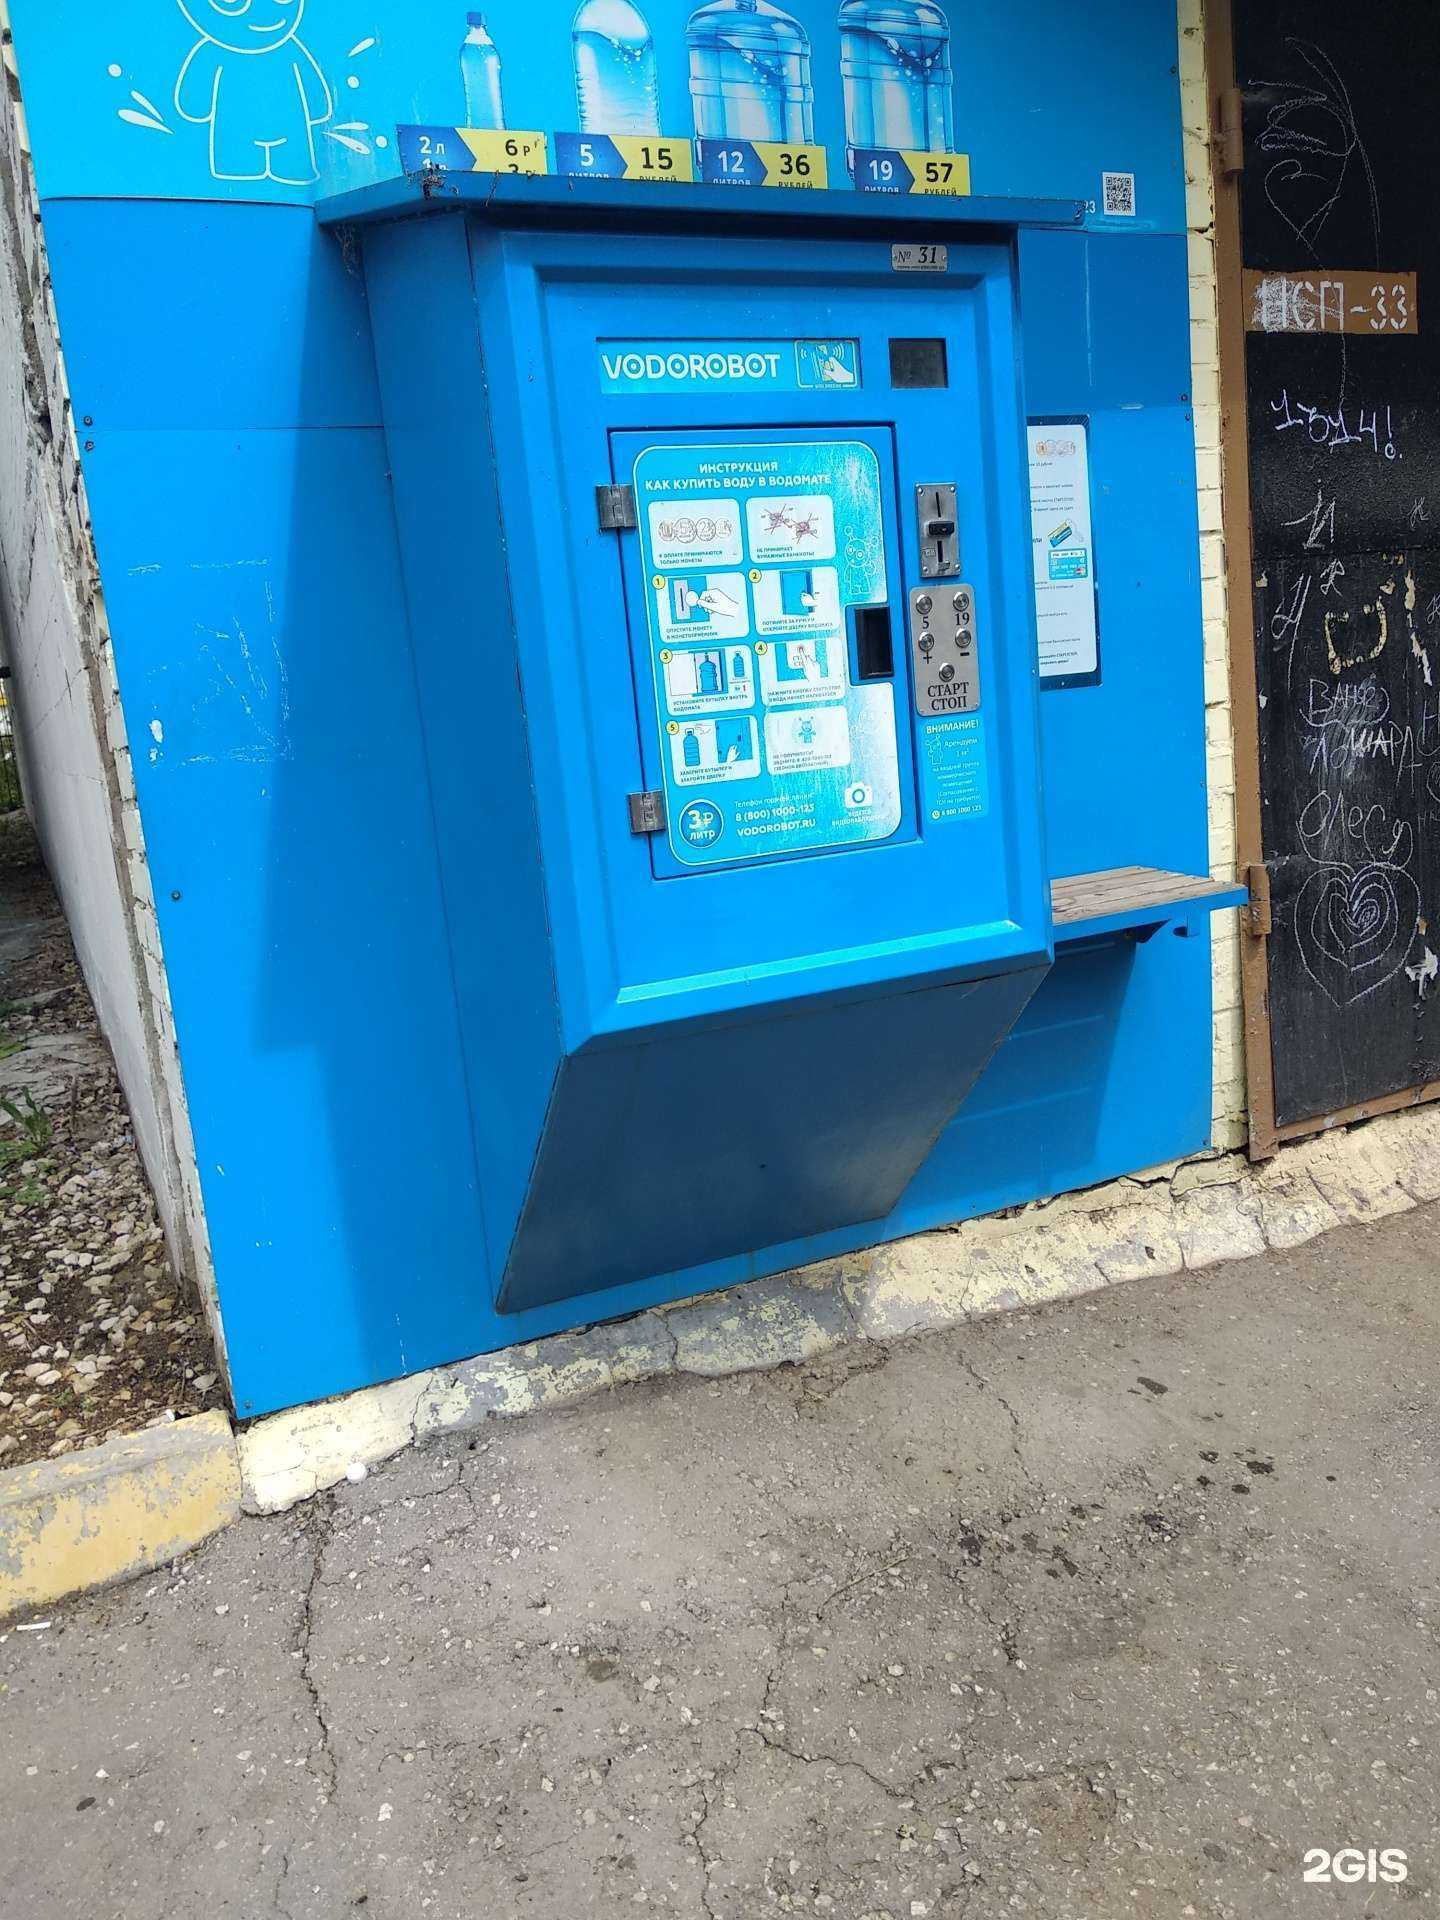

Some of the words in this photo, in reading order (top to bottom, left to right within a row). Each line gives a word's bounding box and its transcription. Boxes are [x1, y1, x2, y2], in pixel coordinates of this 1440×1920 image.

[419, 136, 432, 155] 2
[505, 139, 518, 157] 6
[580, 144, 593, 166] 5
[640, 147, 673, 170] 15
[718, 150, 745, 173] 12
[779, 153, 811, 176] 36
[869, 160, 893, 181] 19
[925, 162, 953, 183] 57
[918, 246, 937, 264] 31
[601, 353, 780, 380] VODOROBOT
[699, 461, 778, 474] ИНСТРУКЦИЯ
[645, 480, 670, 490] КАК
[673, 478, 721, 490] КУПИТЬ
[723, 476, 754, 489] ВОДУ
[757, 476, 766, 487] В
[769, 473, 832, 487] ВОДОМАТЕ
[922, 616, 930, 629] 5
[955, 613, 970, 626] 19
[927, 682, 970, 698] СТАРТ
[931, 696, 967, 711] СТОП
[926, 719, 979, 734] ВНИМАНИЕ!
[735, 798, 762, 808] Телефон
[735, 812, 742, 822] 8
[744, 808, 770, 823] (800)
[736, 818, 816, 837] VODOROBOT.RU
